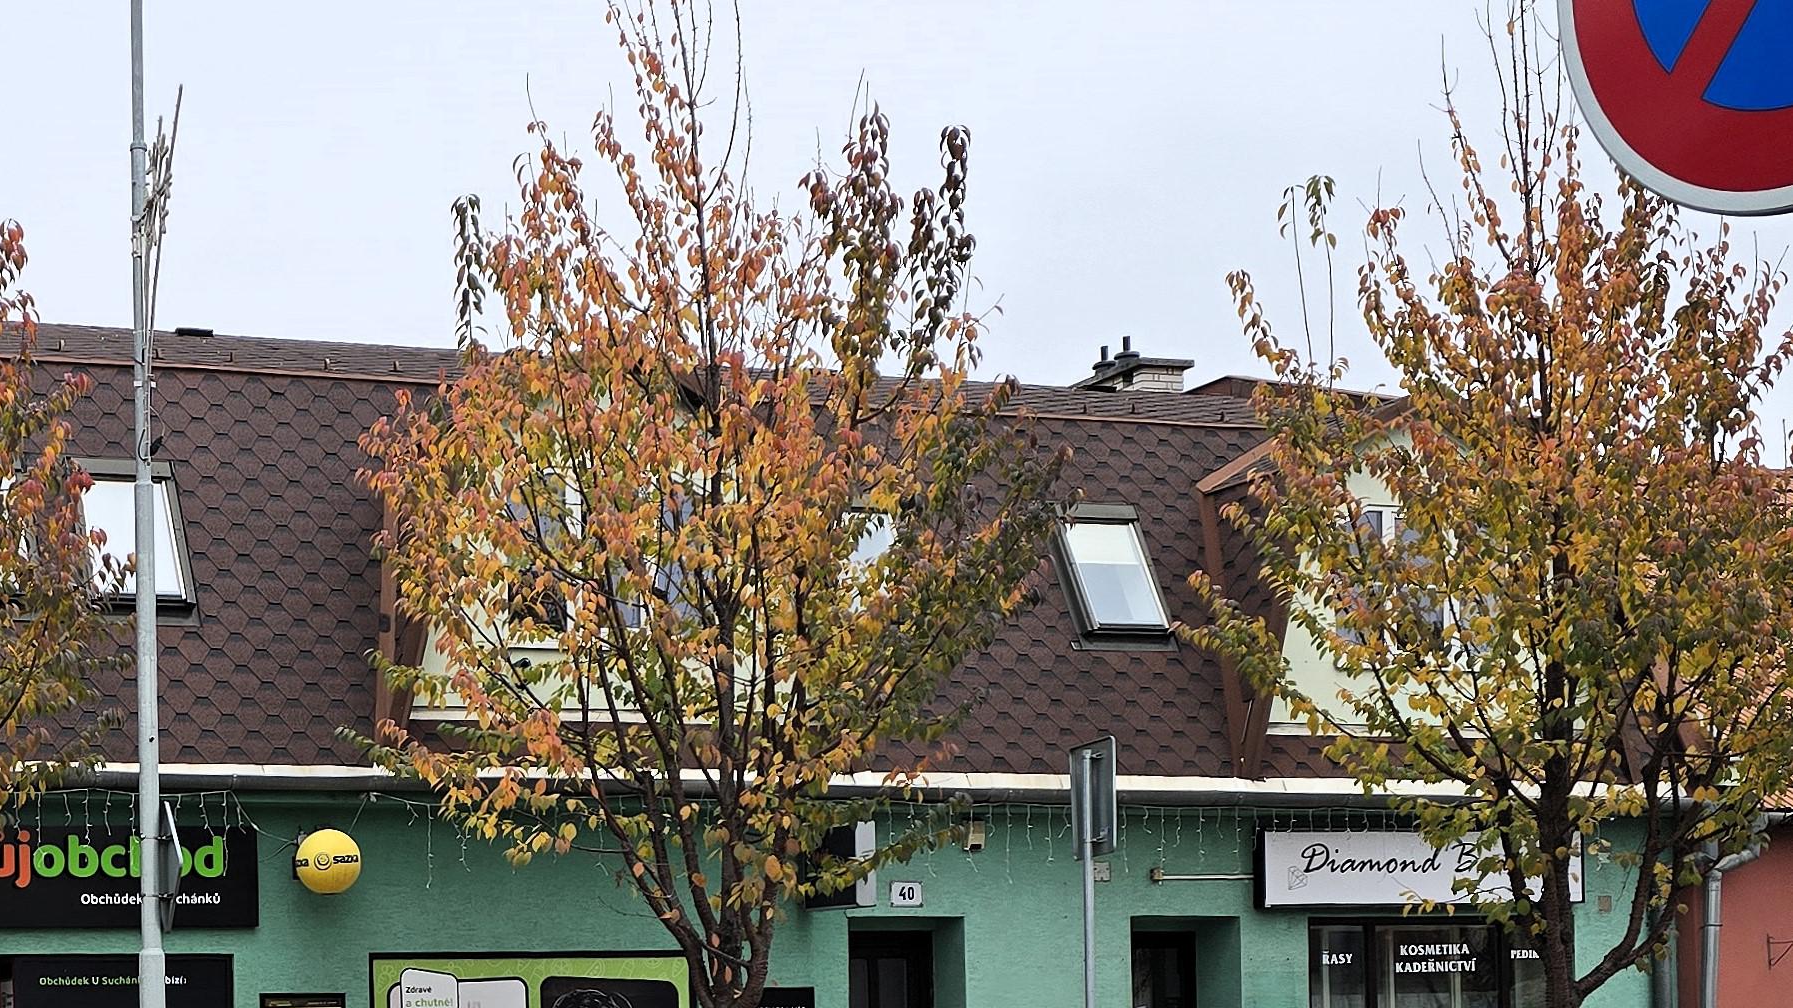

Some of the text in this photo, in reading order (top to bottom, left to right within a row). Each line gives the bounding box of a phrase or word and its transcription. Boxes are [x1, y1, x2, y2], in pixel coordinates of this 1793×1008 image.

[1300, 842, 1442, 873] Diamond
[80, 892, 221, 904] Obchůdek chánků
[899, 886, 914, 900] 40
[1399, 944, 1470, 956] KOSMETIKA
[1322, 951, 1353, 965] ŘASY
[1395, 958, 1477, 973] KADEŘNICTVÍ
[39, 976, 89, 986] Obchůdek
[92, 976, 99, 985] U
[101, 975, 141, 985] Suchán
